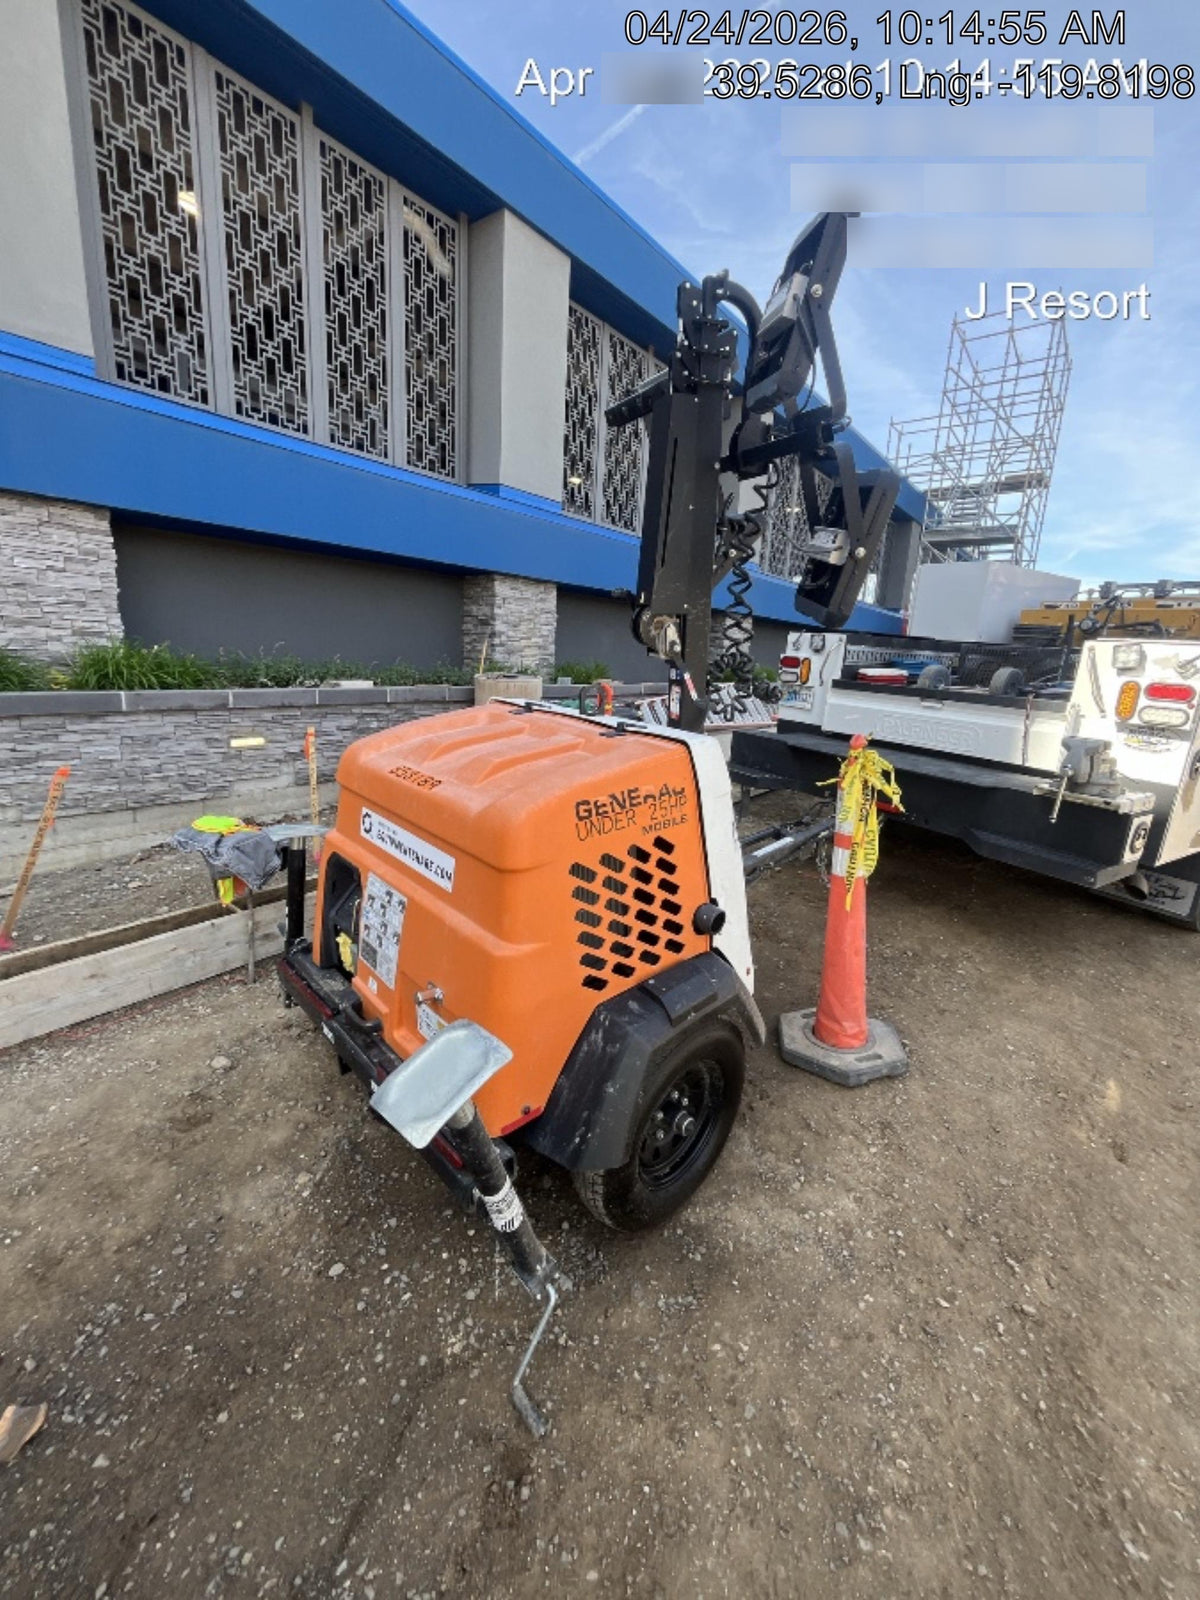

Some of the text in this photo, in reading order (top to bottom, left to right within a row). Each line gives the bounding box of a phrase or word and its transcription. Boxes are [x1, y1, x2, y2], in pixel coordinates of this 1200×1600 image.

[575, 794, 687, 842] UNDER 25HP
[641, 813, 688, 836] MOBILE
